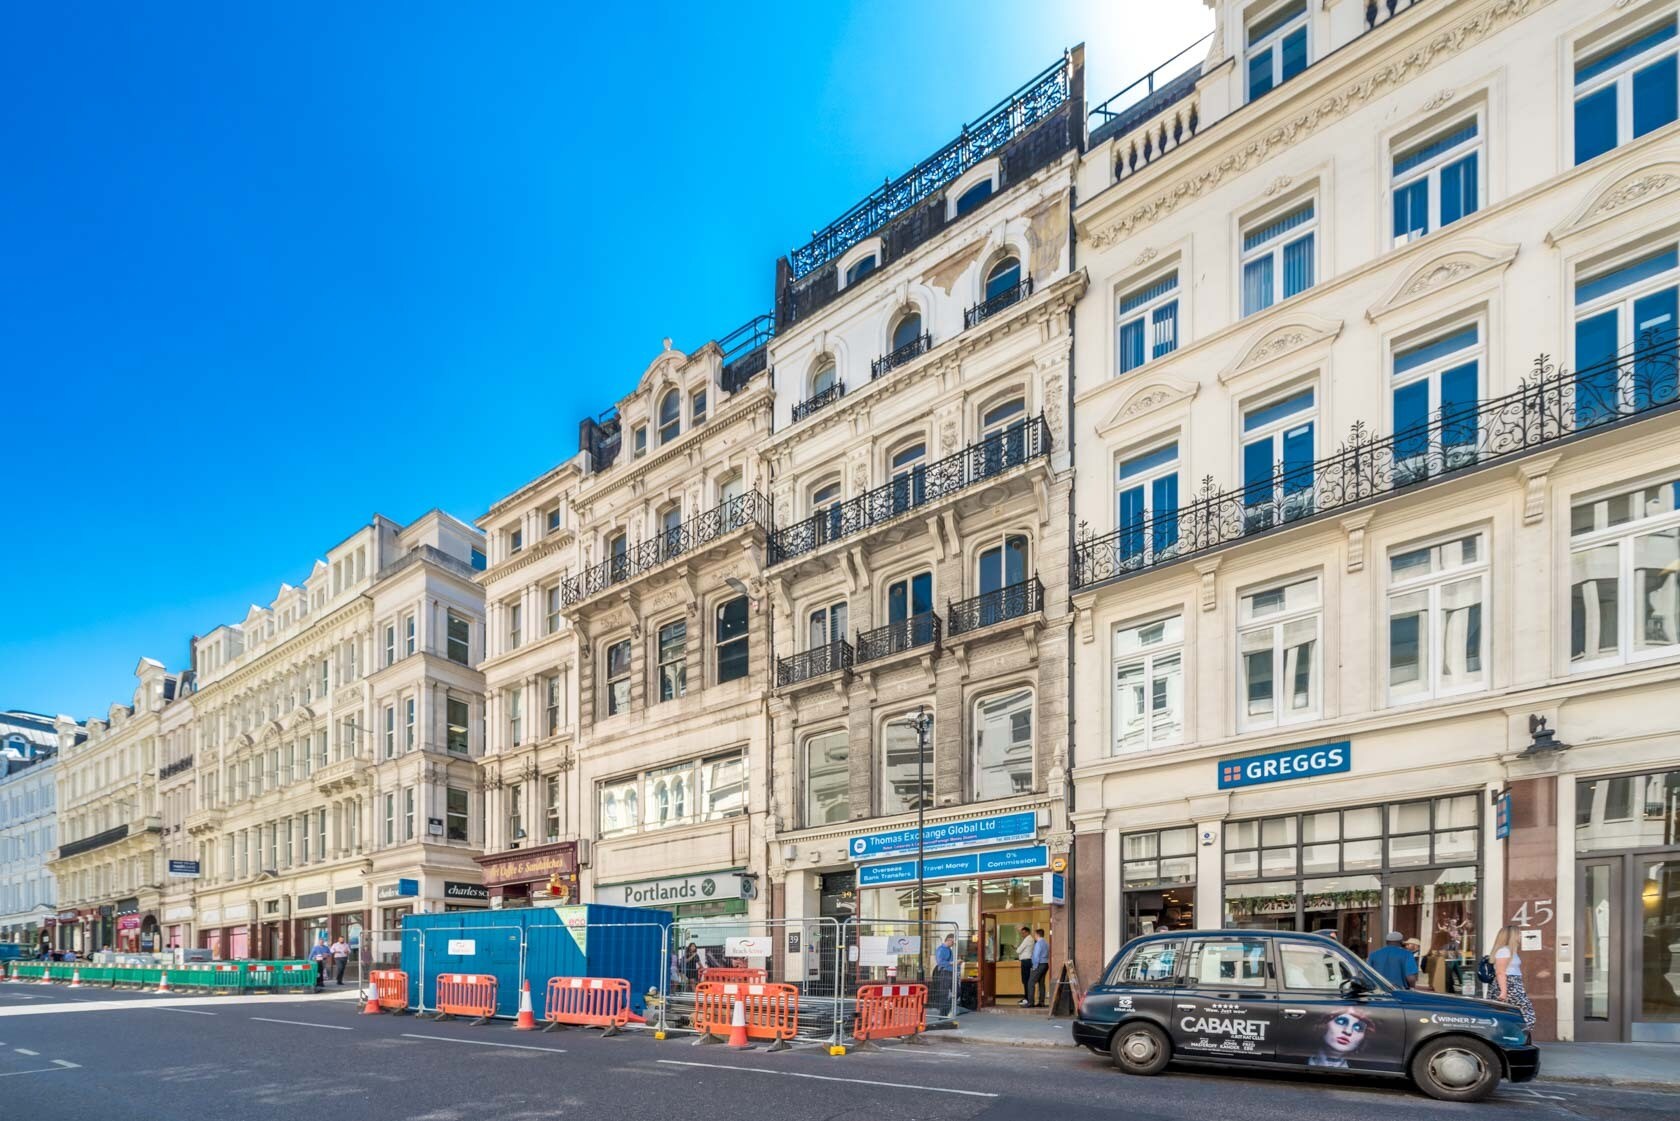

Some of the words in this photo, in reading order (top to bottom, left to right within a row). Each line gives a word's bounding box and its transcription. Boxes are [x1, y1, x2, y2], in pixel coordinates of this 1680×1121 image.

[1246, 749, 1344, 779] GREGGS
[870, 835, 902, 845] Thomas
[948, 822, 978, 835] Global
[980, 820, 995, 831] Ltd
[518, 863, 524, 874] &
[872, 866, 902, 874] Overseas
[987, 858, 1037, 868] Commission
[448, 885, 478, 896] charles
[624, 879, 696, 903] Portlands
[1511, 899, 1553, 927] 45
[789, 935, 799, 944] 39
[1180, 1016, 1270, 1036] CABARET
